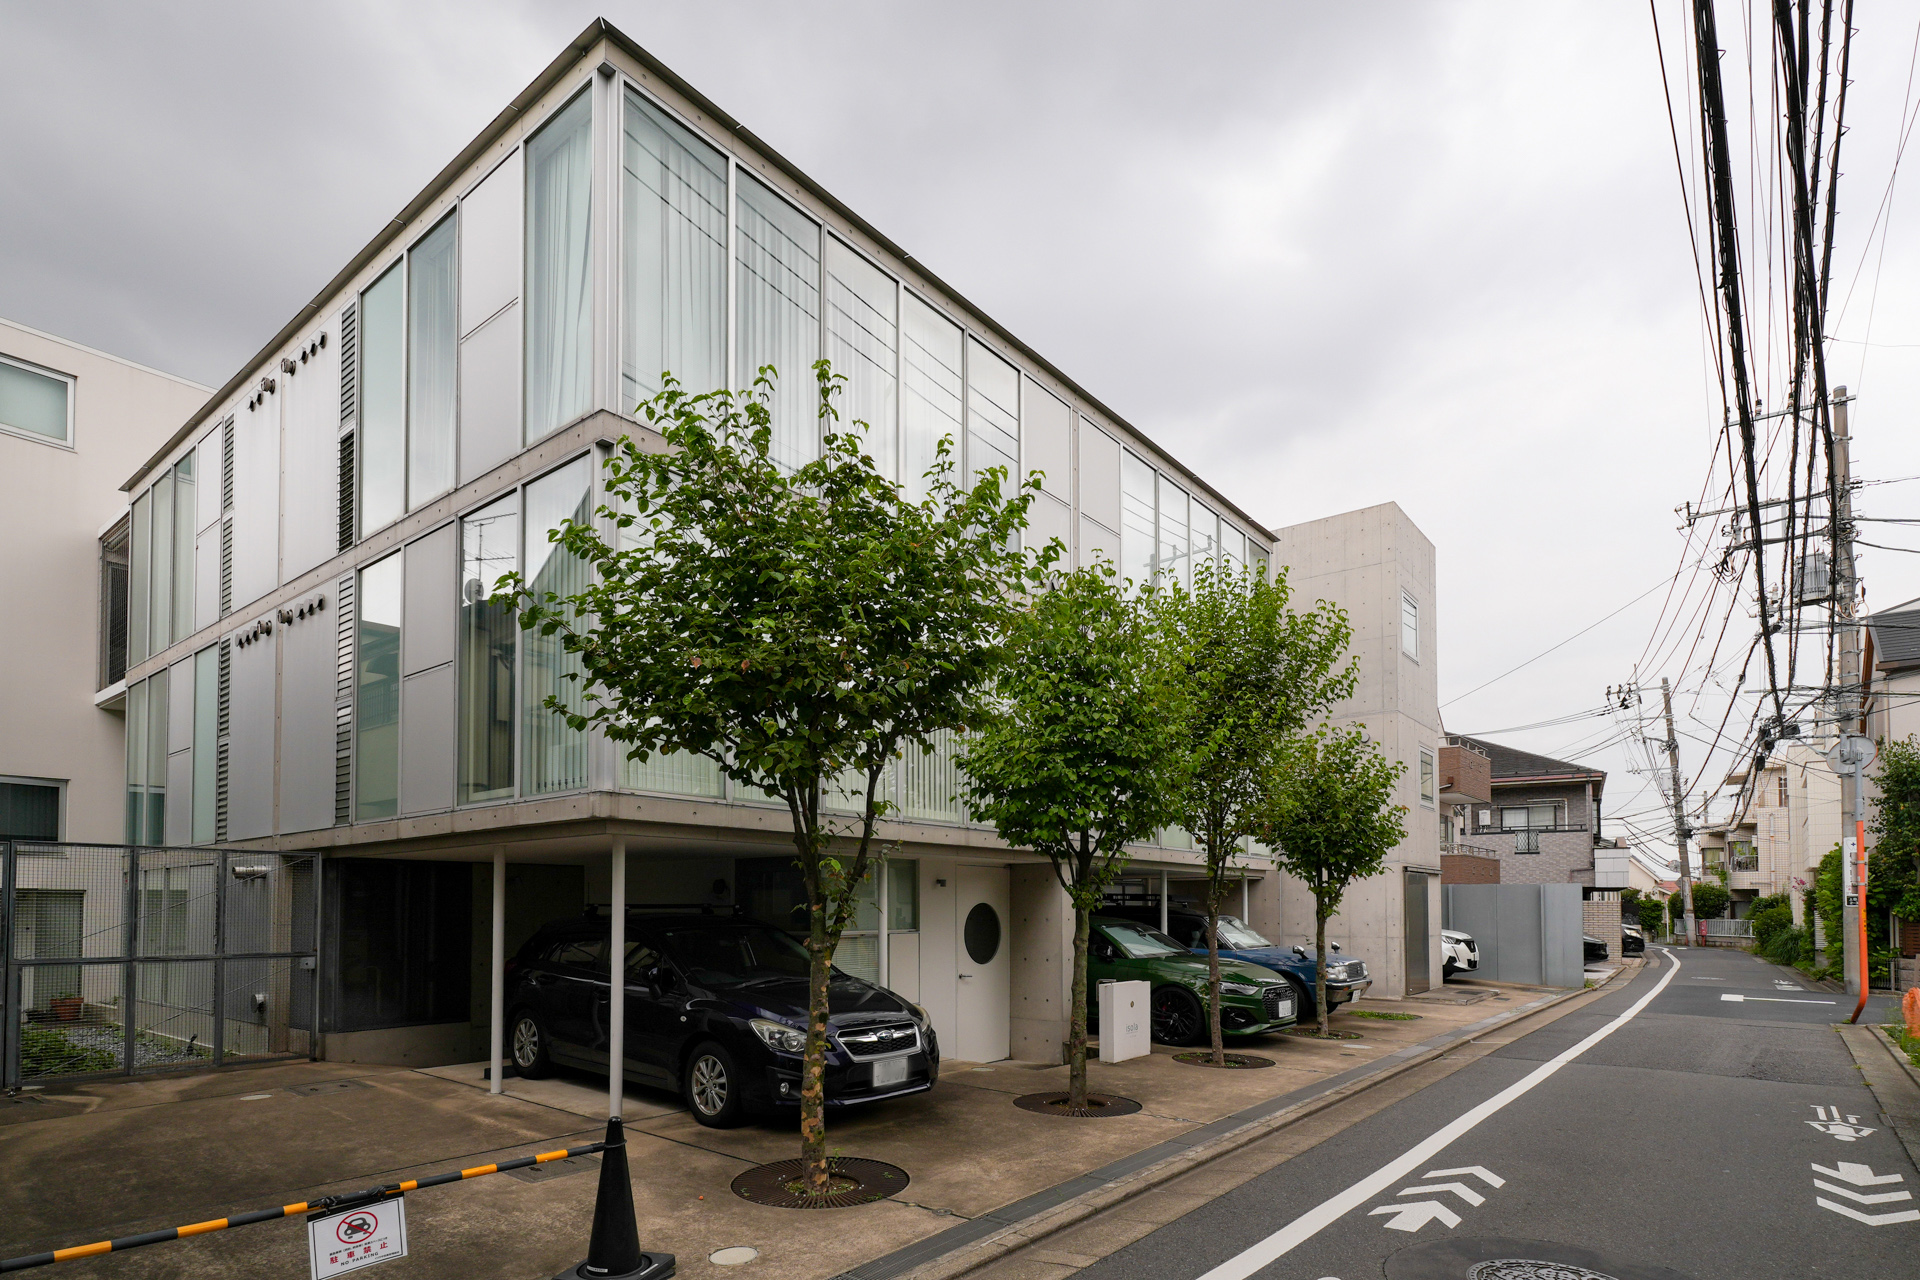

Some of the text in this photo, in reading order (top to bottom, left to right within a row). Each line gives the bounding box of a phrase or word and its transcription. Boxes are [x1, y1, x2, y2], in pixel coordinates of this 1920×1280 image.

[330, 1241, 388, 1264] 駐車禁止
[352, 1251, 379, 1263] PARKING
